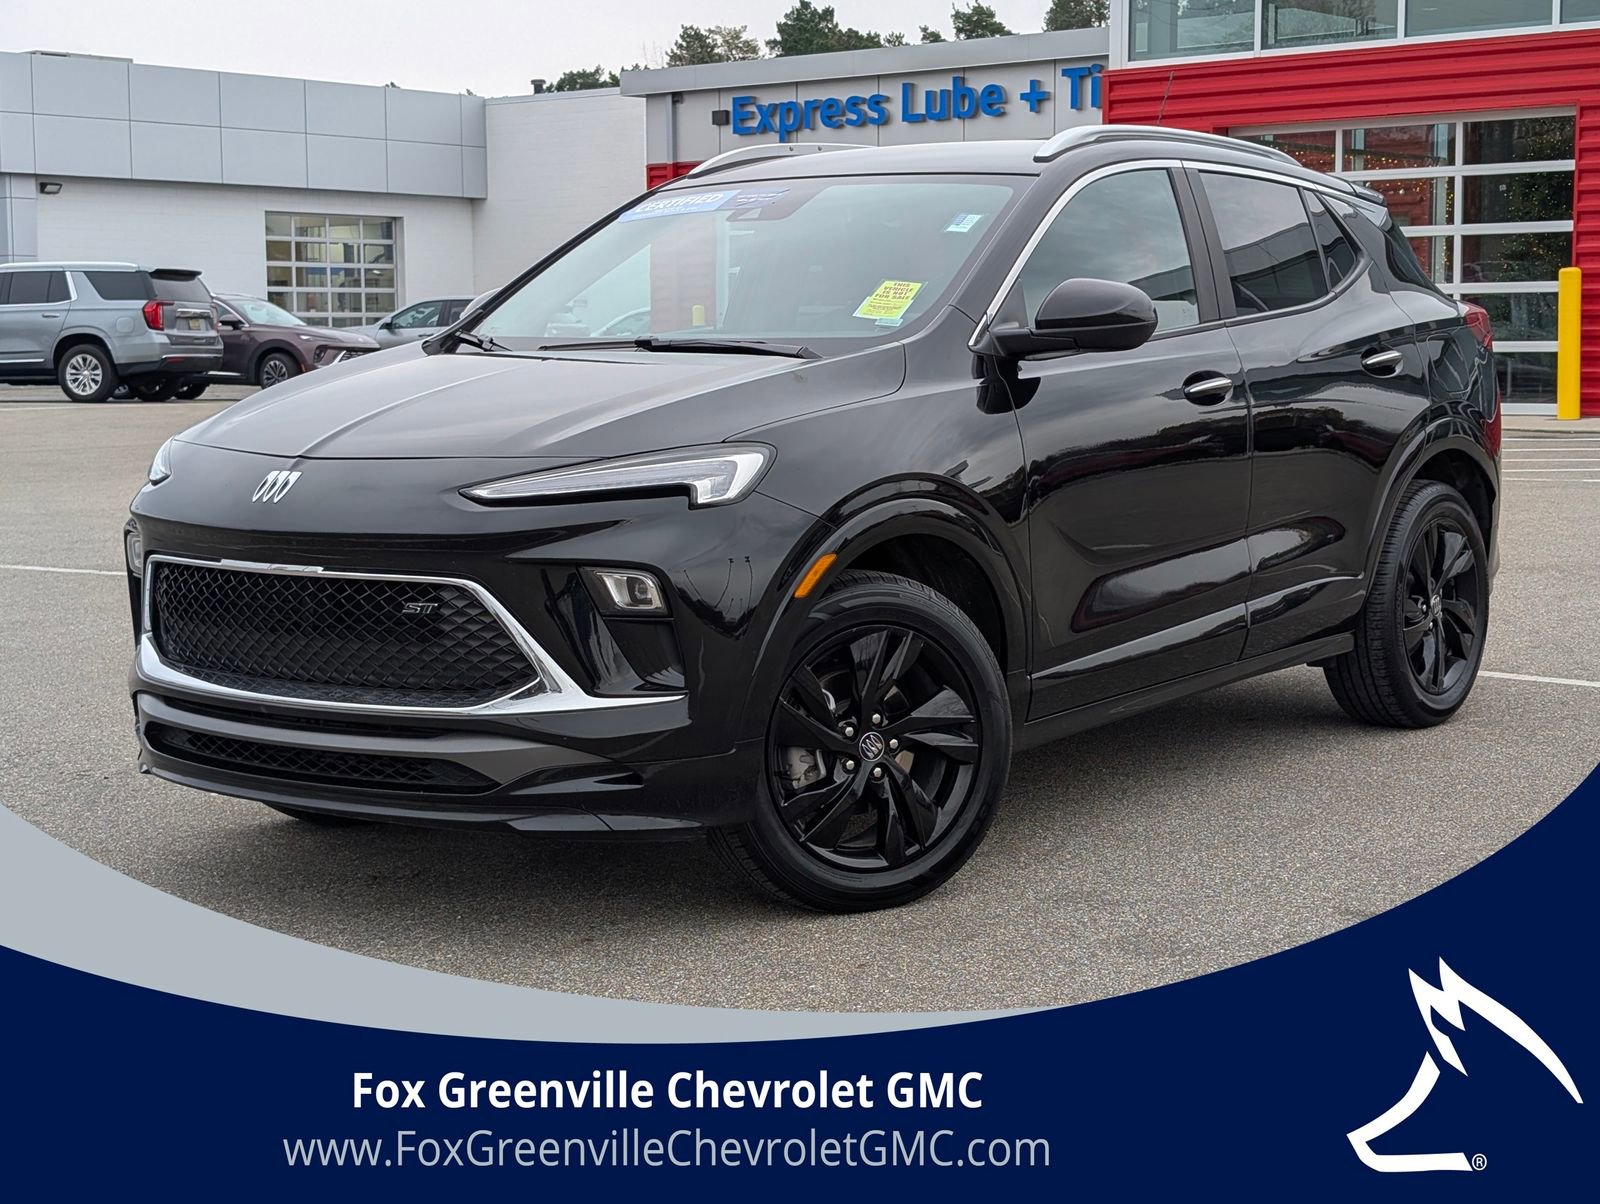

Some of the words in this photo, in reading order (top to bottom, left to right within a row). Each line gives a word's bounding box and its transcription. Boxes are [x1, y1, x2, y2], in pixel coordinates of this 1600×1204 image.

[732, 94, 890, 143] Express
[902, 76, 1008, 123] Lube
[635, 193, 725, 213] CERTIFIED
[402, 602, 438, 614] ST
